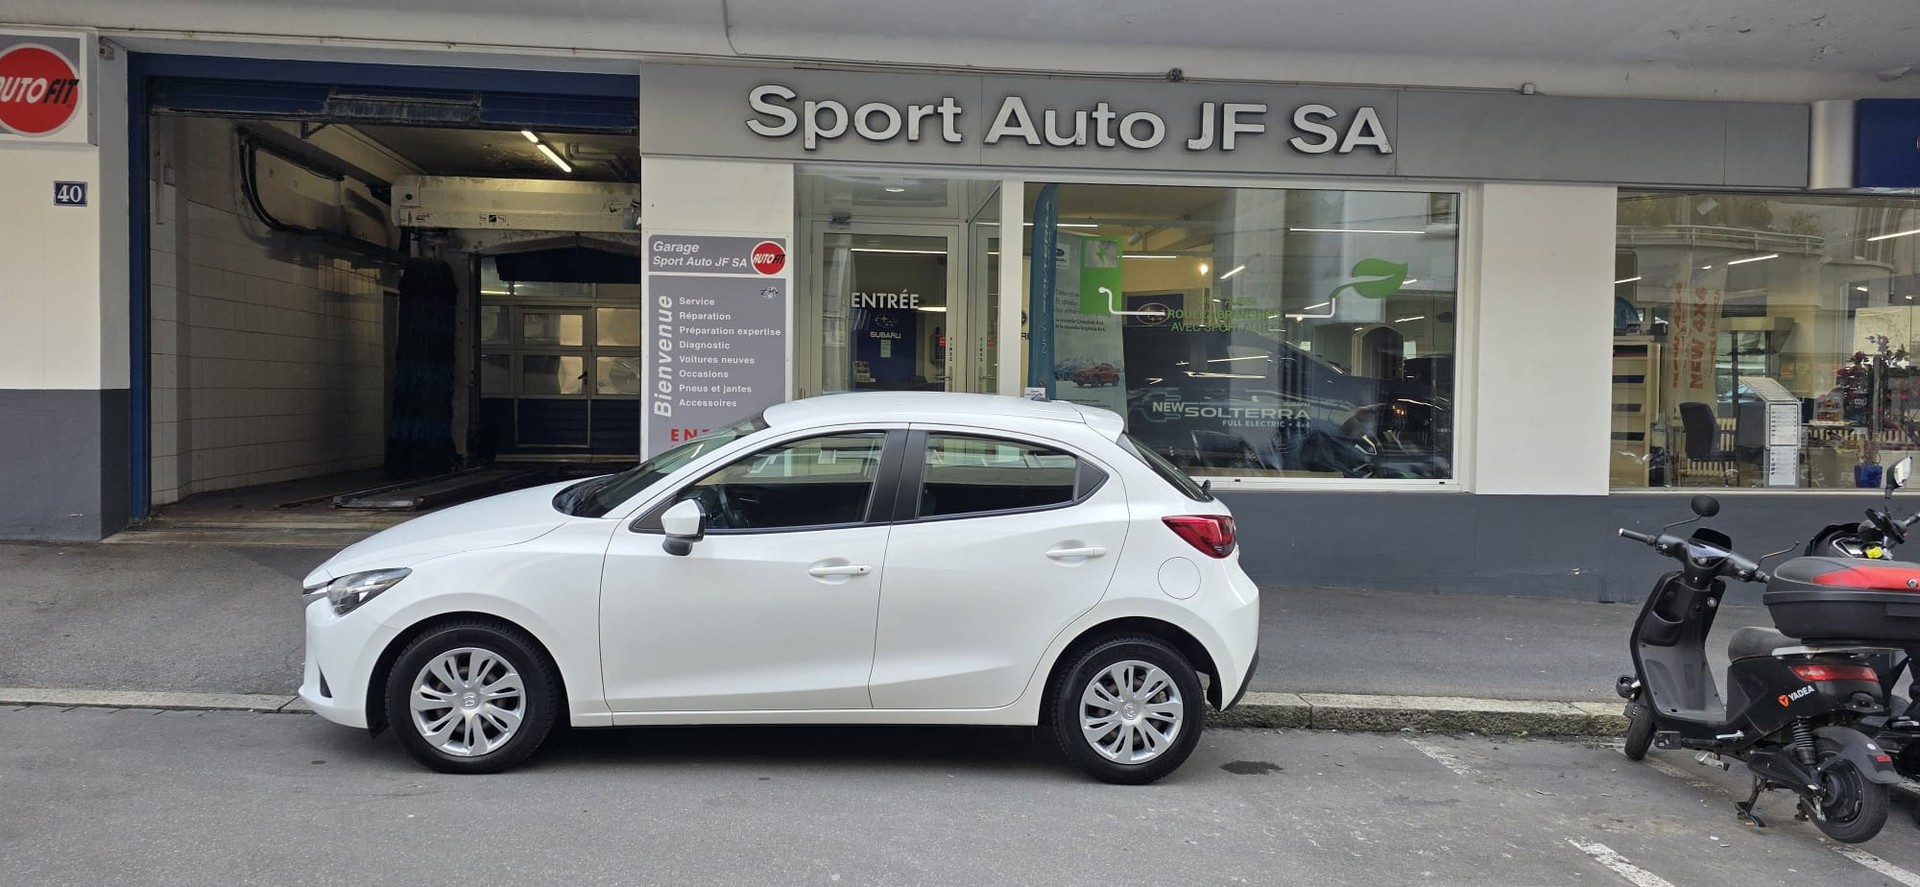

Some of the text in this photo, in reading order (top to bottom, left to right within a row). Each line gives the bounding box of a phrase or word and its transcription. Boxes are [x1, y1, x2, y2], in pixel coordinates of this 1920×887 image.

[746, 84, 1393, 154] Sport Auto JF SA
[57, 185, 83, 203] 40
[653, 241, 699, 255] Garage
[653, 256, 748, 268] Sport Auto JF SA
[753, 253, 785, 264] AUTOFIT
[679, 297, 715, 306] Service
[851, 289, 919, 309] ENTRÉE
[679, 312, 731, 321] Réparation
[679, 326, 781, 337] Préparation expertise
[870, 331, 901, 339] SUBARU
[679, 341, 730, 350] Diagnostic
[654, 295, 672, 418] Bienvenue
[679, 355, 719, 364] Voitures
[1690, 337, 1705, 389] NEW
[679, 369, 729, 378] Occasions
[679, 384, 752, 394] Pneus et jantes
[679, 399, 737, 407] Accessoires
[1153, 402, 1311, 420] NEW SOLTERRA
[1245, 420, 1285, 428] ELECTRIC
[1788, 685, 1815, 701] YADEA
